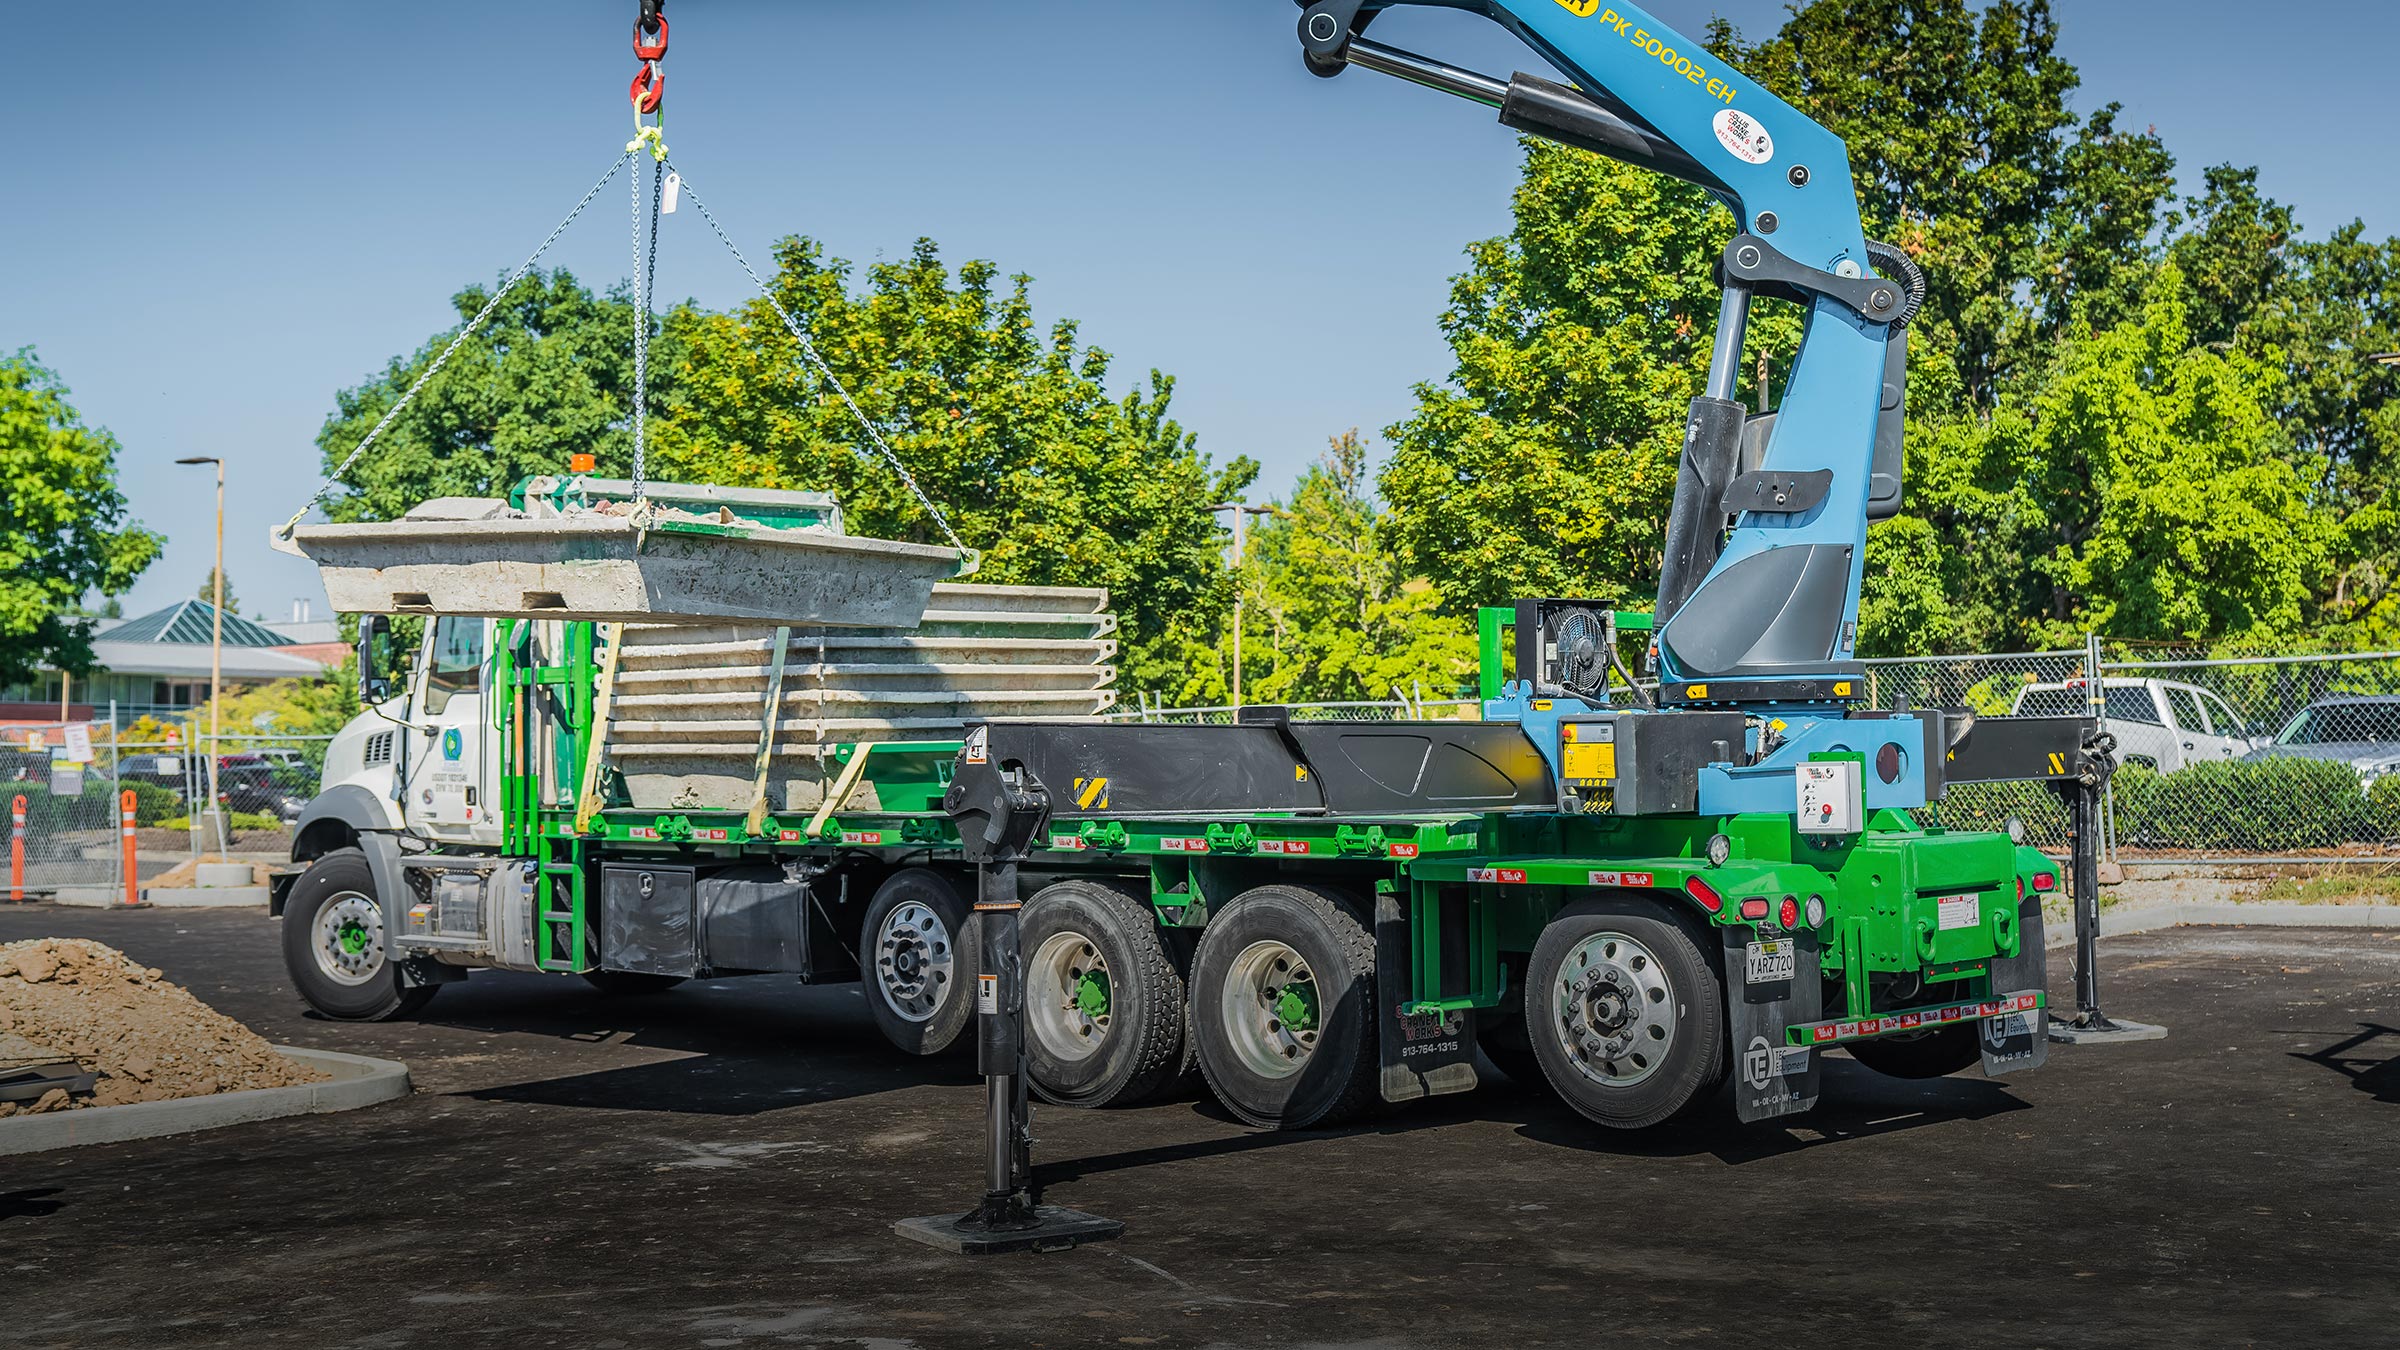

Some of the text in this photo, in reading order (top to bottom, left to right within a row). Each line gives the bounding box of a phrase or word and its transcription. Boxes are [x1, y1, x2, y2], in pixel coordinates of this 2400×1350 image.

[1599, 8, 1633, 37] PK
[1727, 117, 1750, 136] CRANE
[1729, 111, 1750, 129] COLLIS
[1727, 125, 1751, 145] WORKS
[1716, 128, 1757, 163] 913-764-1315
[1750, 954, 1793, 976] YARZ720
[1406, 1024, 1442, 1041] WORKS
[1402, 1041, 1458, 1057] 913-764-1315
